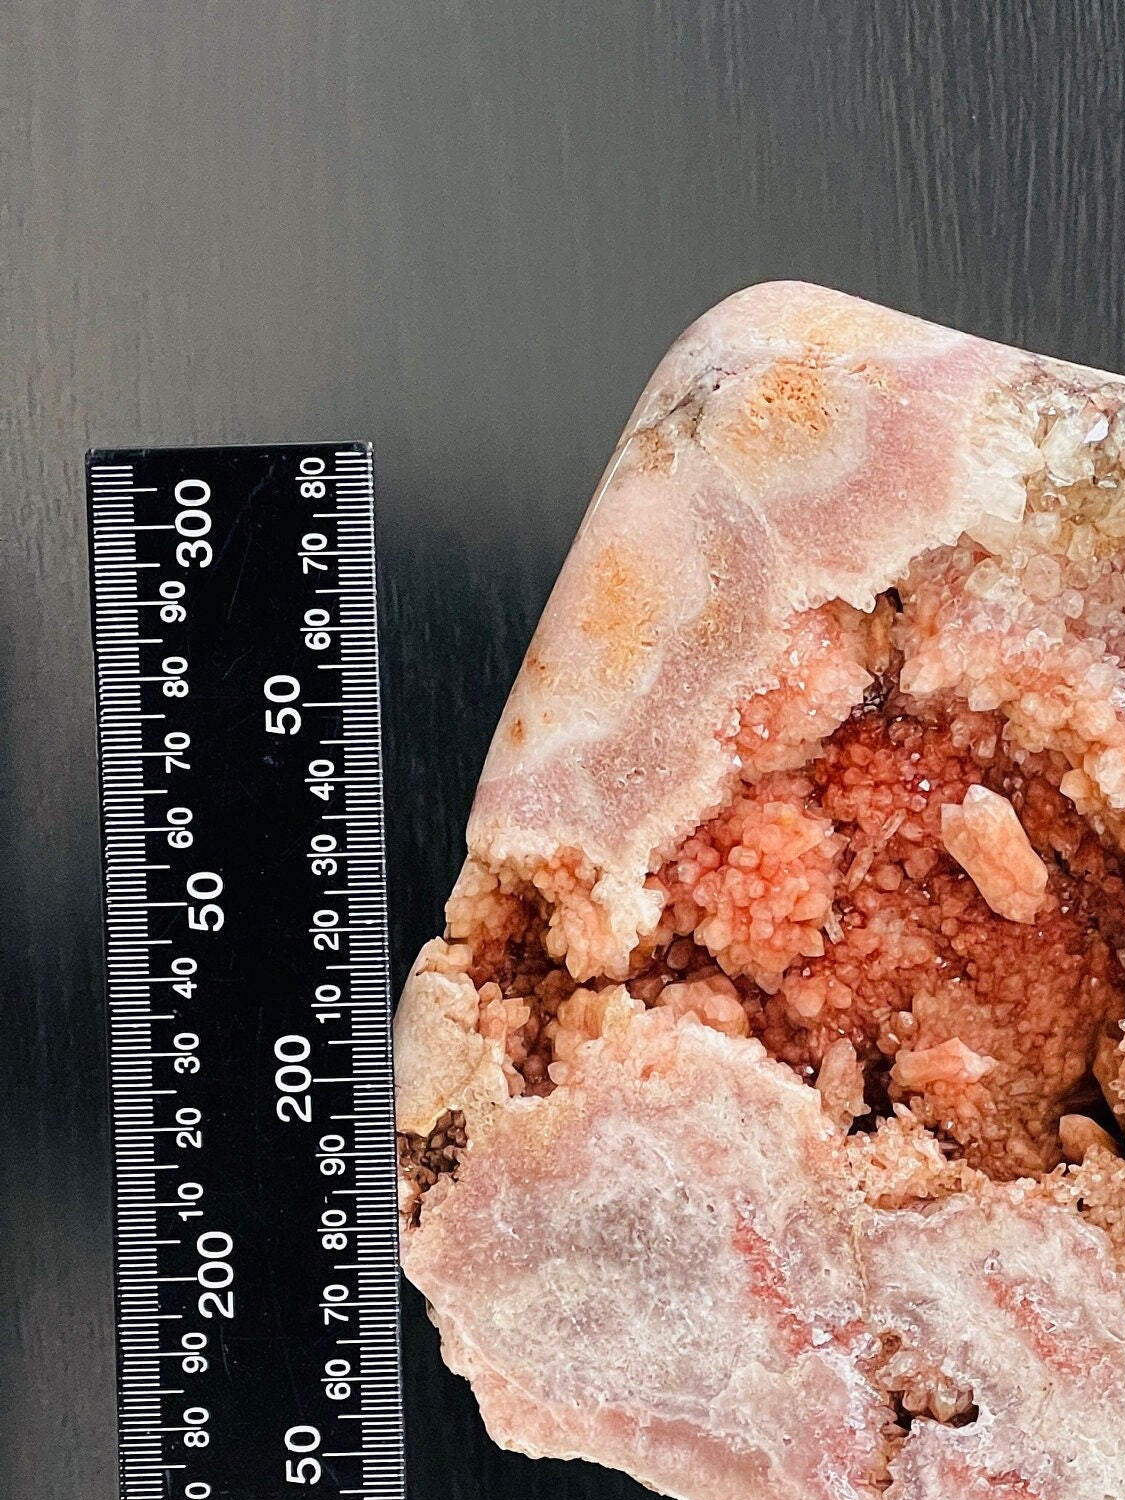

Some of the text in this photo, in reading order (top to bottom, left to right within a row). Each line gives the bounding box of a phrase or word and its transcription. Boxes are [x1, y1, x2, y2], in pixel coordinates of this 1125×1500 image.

[299, 457, 326, 498] 80
[175, 479, 213, 568] 300
[302, 533, 327, 574] 70
[159, 580, 186, 623] 90
[305, 608, 331, 650] 60
[163, 656, 190, 698] 80
[264, 675, 301, 735] 50
[165, 732, 191, 773] 70
[309, 759, 335, 800] 40
[168, 807, 193, 849] 60
[311, 834, 337, 876] 30
[186, 871, 224, 931] 50
[313, 909, 339, 951] 20
[171, 957, 198, 998] 40
[314, 984, 341, 1023] 10
[174, 1032, 200, 1074] 30
[275, 1035, 313, 1123] 200
[176, 1107, 202, 1148] 20
[320, 1134, 346, 1176] 90
[178, 1182, 204, 1221] 10
[321, 1209, 348, 1251] 80
[197, 1231, 234, 1319] 200
[323, 1284, 349, 1324] 70
[181, 1332, 208, 1373] 90
[325, 1359, 351, 1400] 60
[183, 1407, 210, 1448] 80
[285, 1425, 321, 1485] 50
